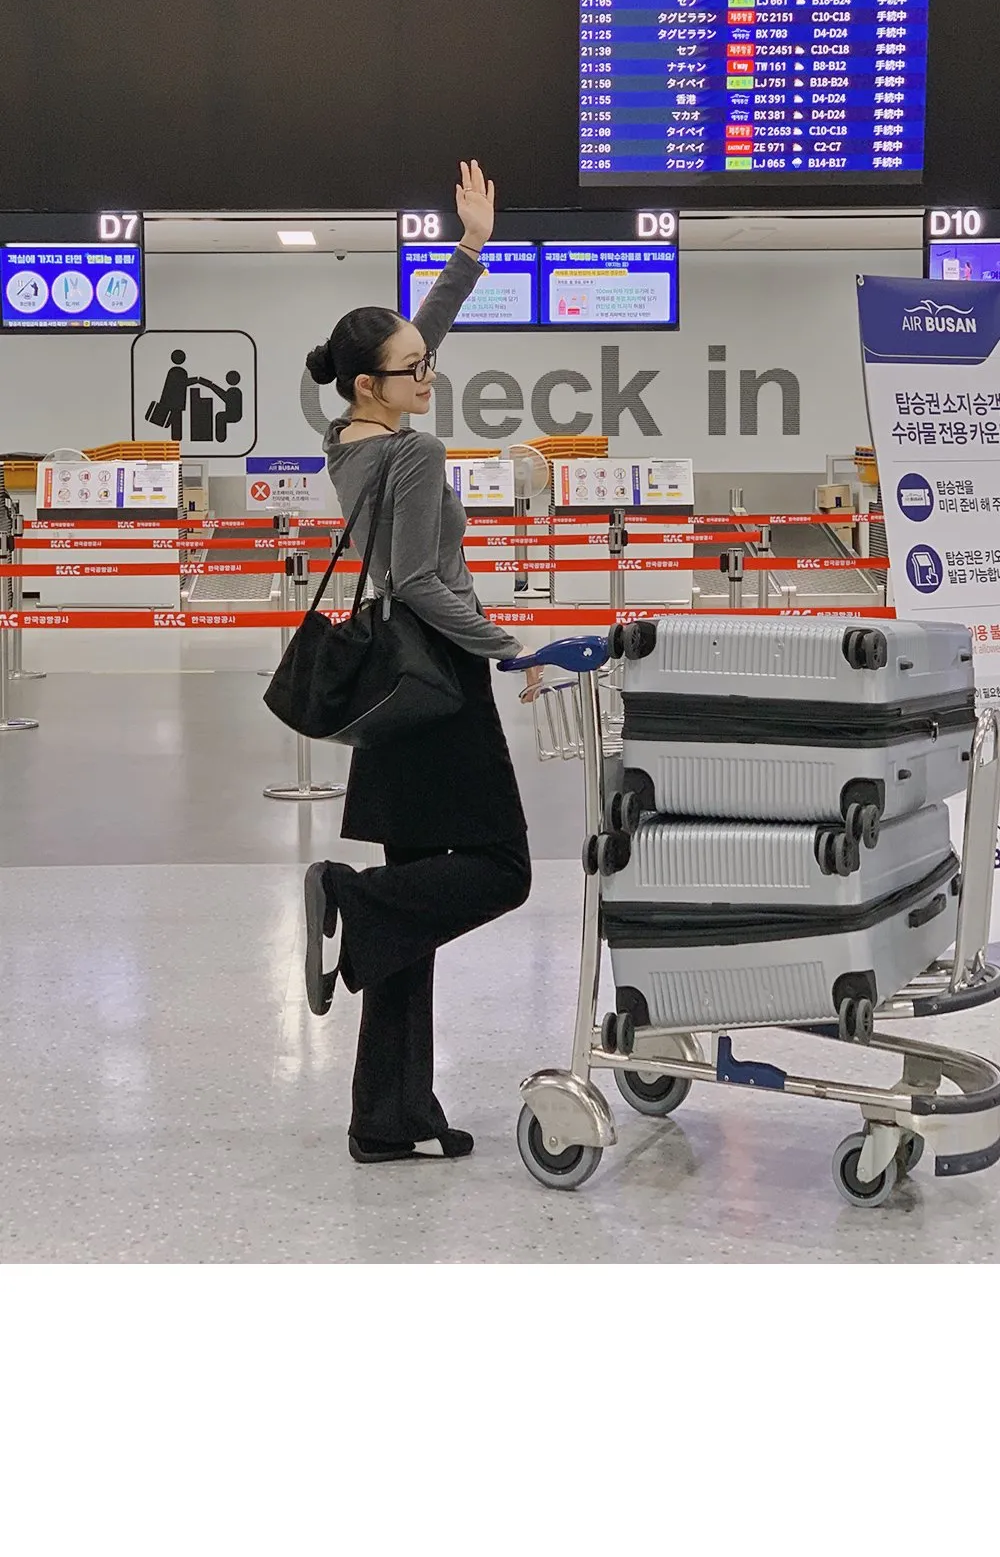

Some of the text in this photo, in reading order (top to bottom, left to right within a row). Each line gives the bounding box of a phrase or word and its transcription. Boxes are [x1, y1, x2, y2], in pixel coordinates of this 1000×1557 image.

[581, 10, 906, 23] 21:05 タグビララン 7C 2151 C10-C18 手続中
[581, 27, 906, 39] 21:25 タグビララン BX 703 D4-D24 手続中
[100, 215, 138, 240] D7
[402, 213, 440, 238] D8
[638, 213, 675, 237] D9
[930, 211, 980, 235] D10
[8, 255, 82, 264] 객실에 가지고 타면
[902, 316, 976, 333] AIR BUSAN
[708, 346, 800, 435] in
[896, 392, 941, 415] 탑승권
[943, 393, 971, 415] 소지
[892, 422, 936, 444] 수하물
[939, 422, 967, 444] 전용
[937, 480, 973, 495] 탑승권을
[939, 498, 958, 512] 미리
[960, 498, 978, 512] 준비
[980, 498, 990, 512] 해
[946, 551, 983, 566] 탑승권은
[56, 565, 80, 575] KAC
[948, 569, 966, 584] 발급
[24, 614, 236, 626] 한국공항공사 KAC 한국공항공사
[490, 613, 534, 622] 한국공항공사
